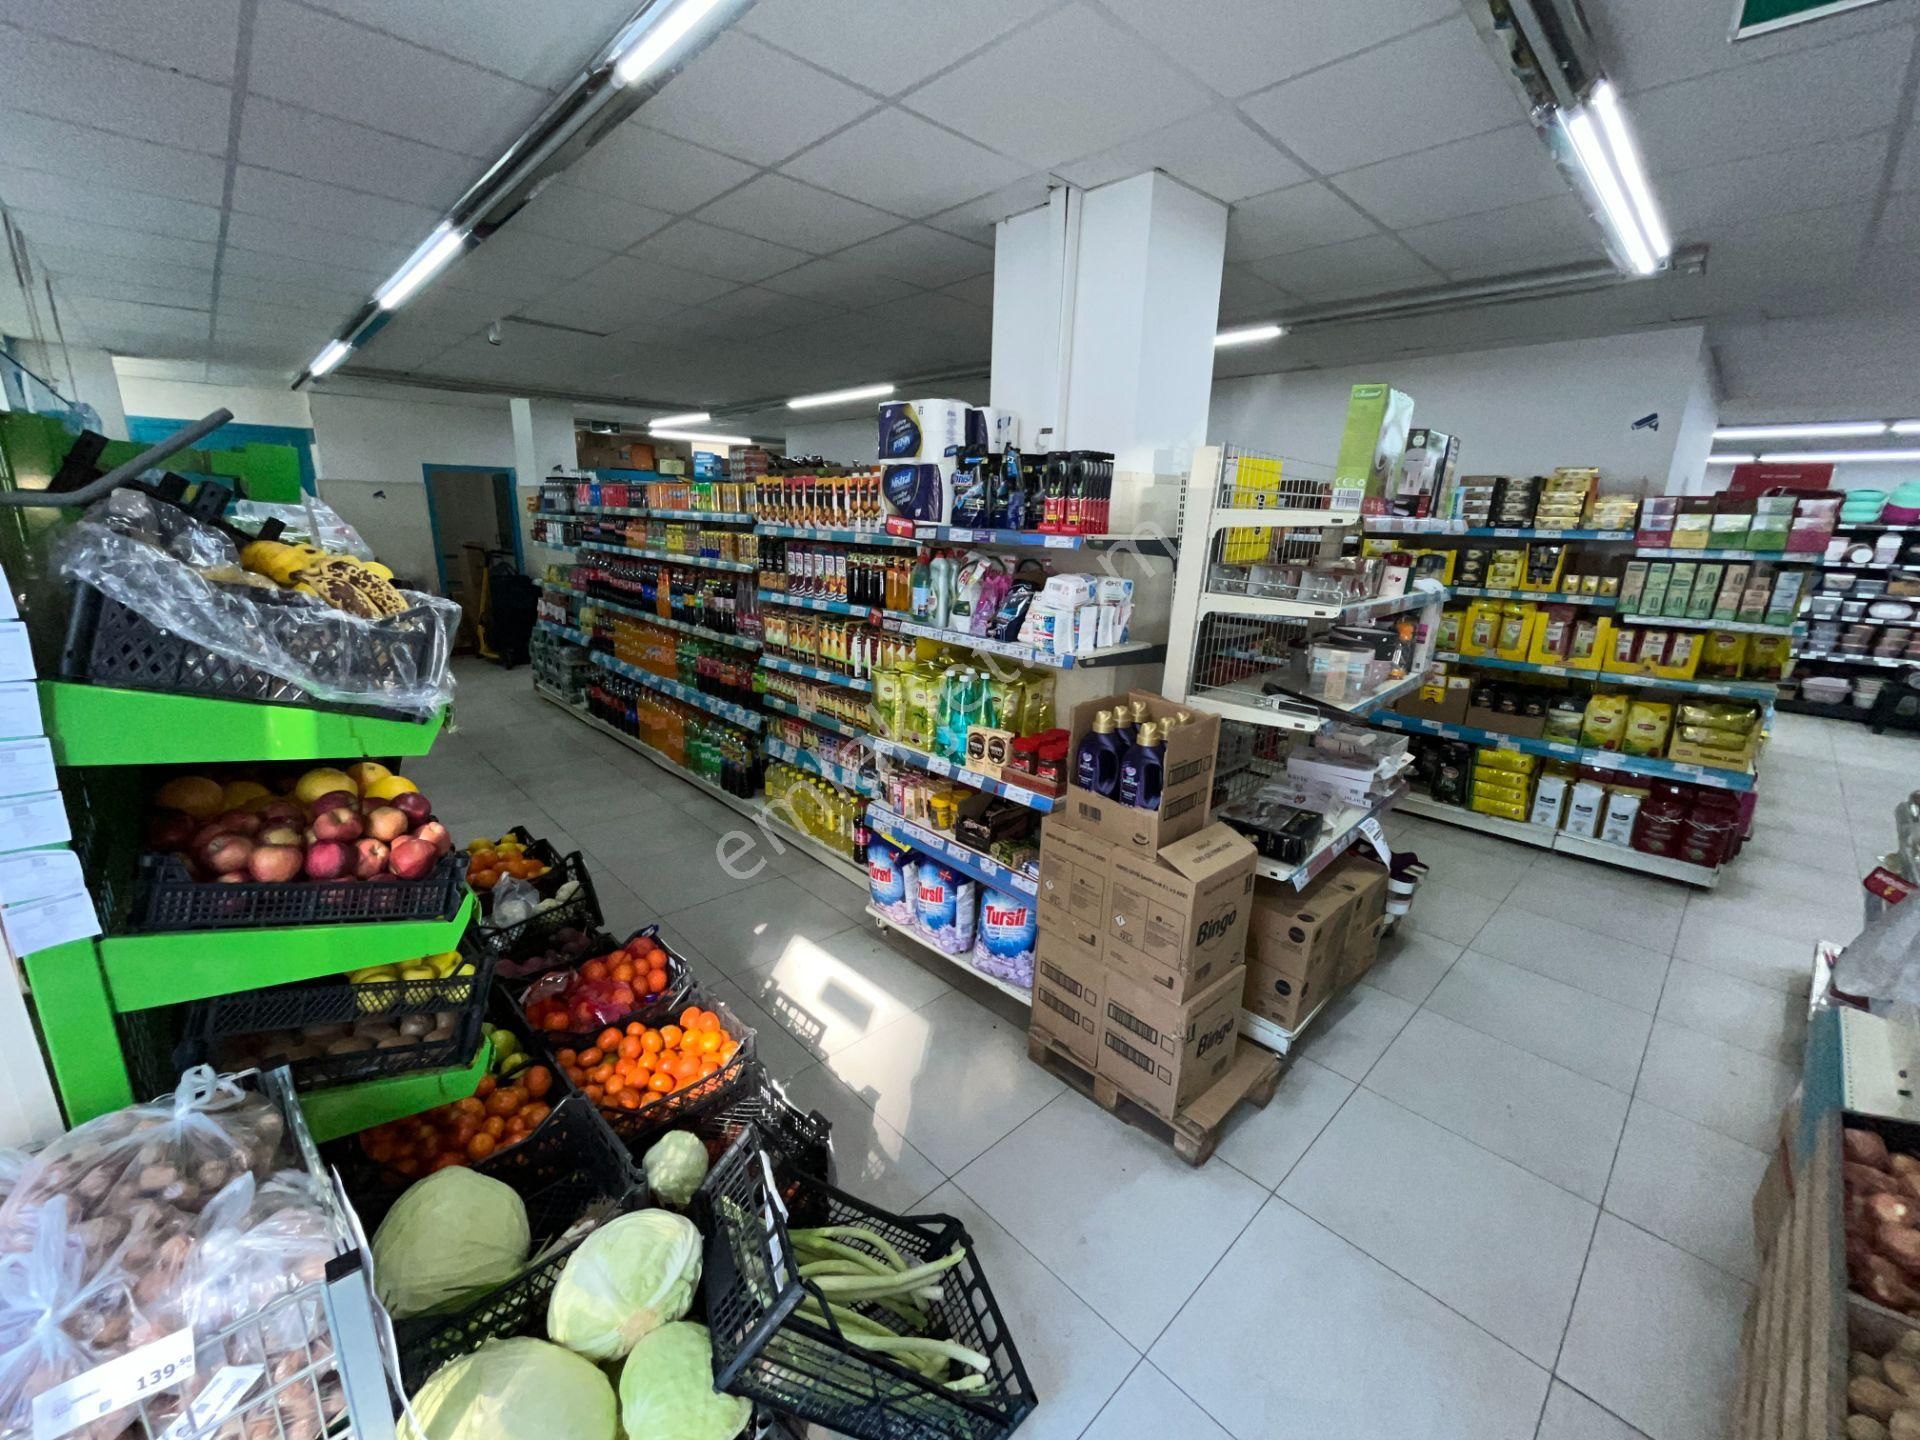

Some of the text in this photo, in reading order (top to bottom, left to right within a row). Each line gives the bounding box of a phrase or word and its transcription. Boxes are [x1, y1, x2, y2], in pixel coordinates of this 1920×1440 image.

[868, 862, 892, 883] Tursil
[985, 905, 1027, 926] Tursil
[1195, 909, 1238, 947] Bingo
[1196, 1018, 1234, 1058] Bingo
